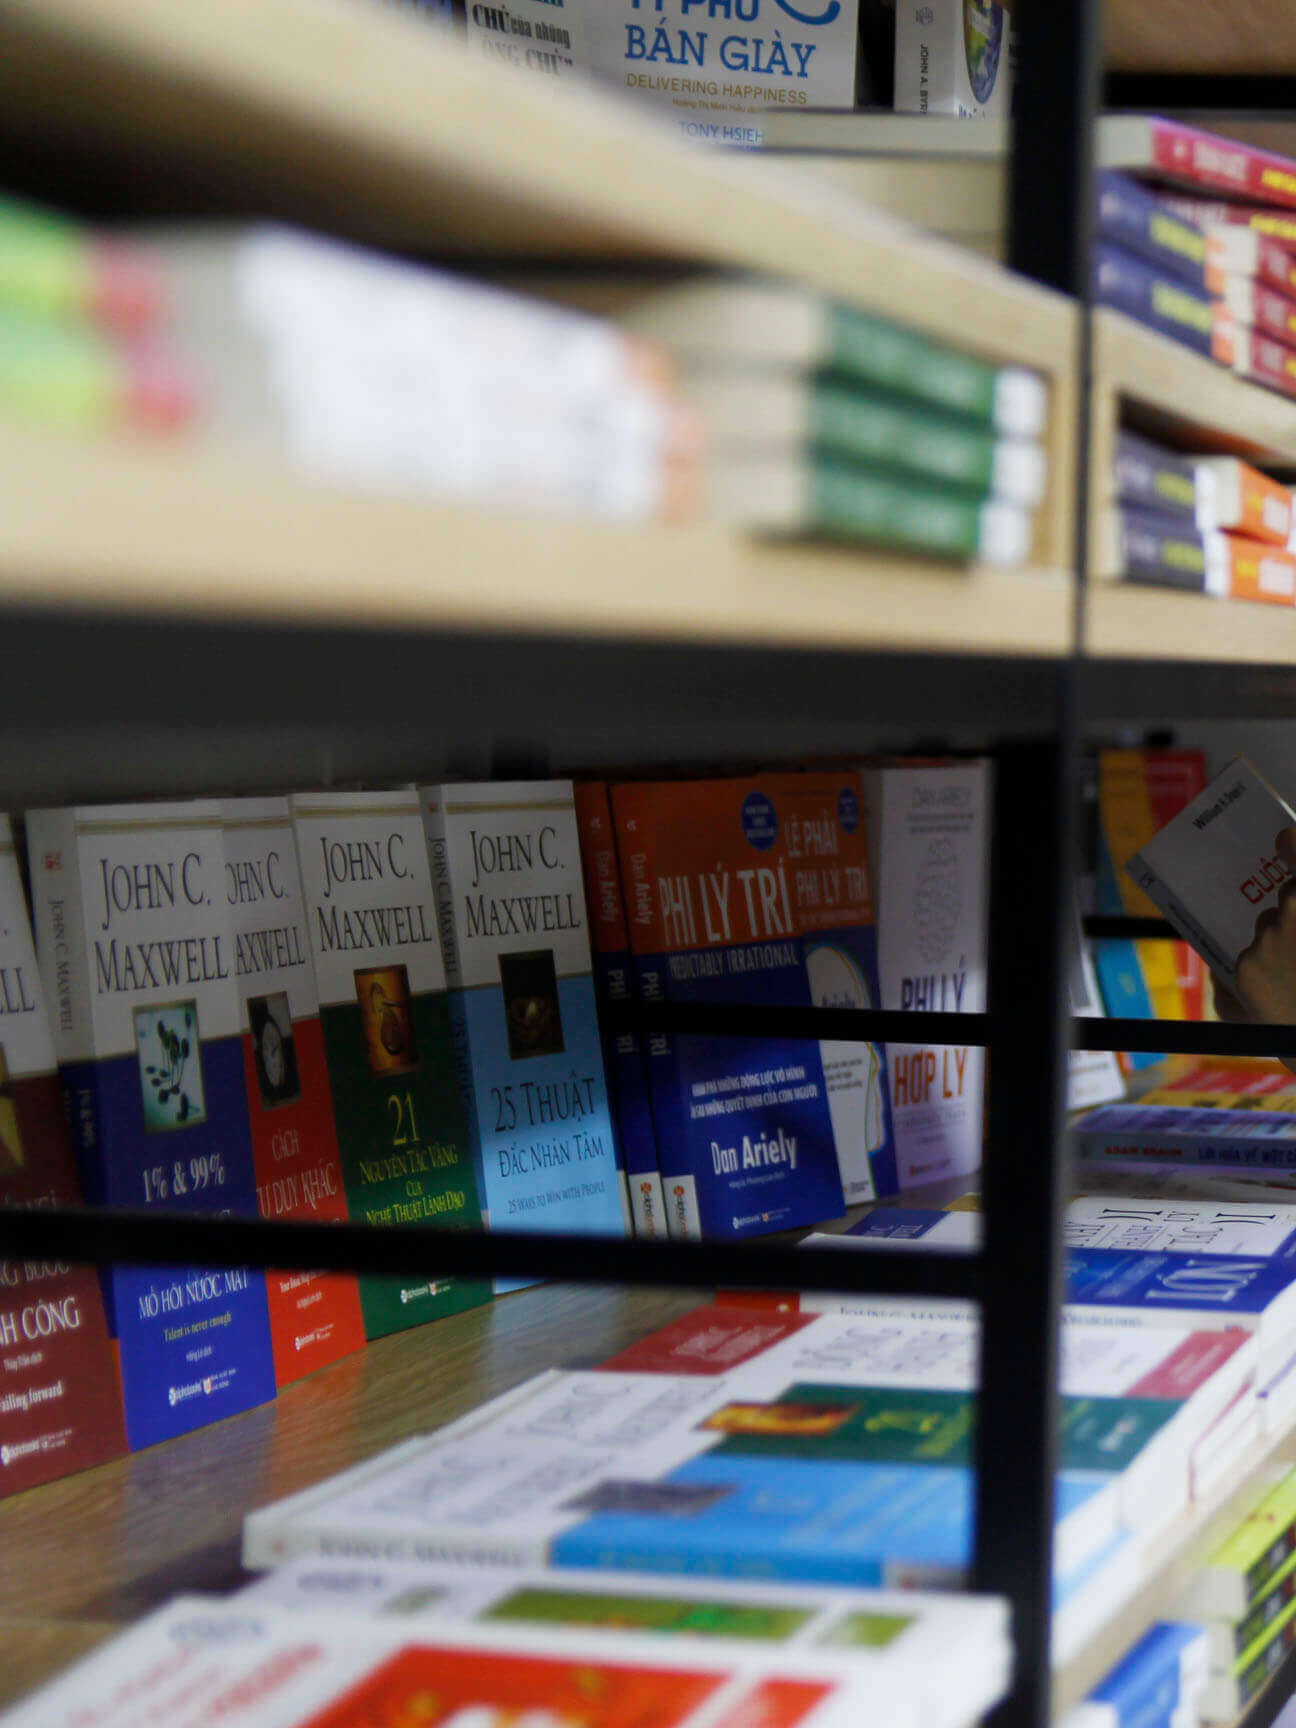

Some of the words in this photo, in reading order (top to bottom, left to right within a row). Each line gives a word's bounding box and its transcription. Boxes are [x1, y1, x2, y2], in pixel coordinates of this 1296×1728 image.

[625, 18, 708, 66] BÁN
[720, 30, 816, 79] GIÀY
[627, 73, 719, 100] DELIVERING
[722, 84, 808, 105] HAPPINESS
[680, 120, 720, 142] TONY
[320, 836, 384, 899] JOHN
[387, 833, 414, 881] C.
[471, 829, 533, 888] JOHN
[539, 826, 566, 871] C.
[101, 857, 176, 931] JOHN
[182, 852, 213, 906] C.
[464, 893, 583, 938] MAXWELL
[658, 874, 698, 947] PHI
[700, 859, 732, 944] LÝ
[735, 856, 794, 940] TRÍ
[235, 926, 306, 977] AXWELL
[316, 904, 434, 952] MAXWELL
[94, 936, 229, 994] MAXWELL
[387, 1092, 420, 1146] 21
[493, 1086, 518, 1132] 25
[523, 1072, 597, 1126] THUẬT
[572, 1131, 605, 1165] TÂM
[711, 1141, 738, 1175] Dan
[742, 1126, 798, 1170] Ariely
[142, 1167, 169, 1203] 1%
[173, 1159, 188, 1198] &
[189, 1152, 226, 1194] 99%
[22, 1297, 82, 1340] CÔNG
[0, 1393, 29, 1413] ailing
[30, 1379, 65, 1406] forward
